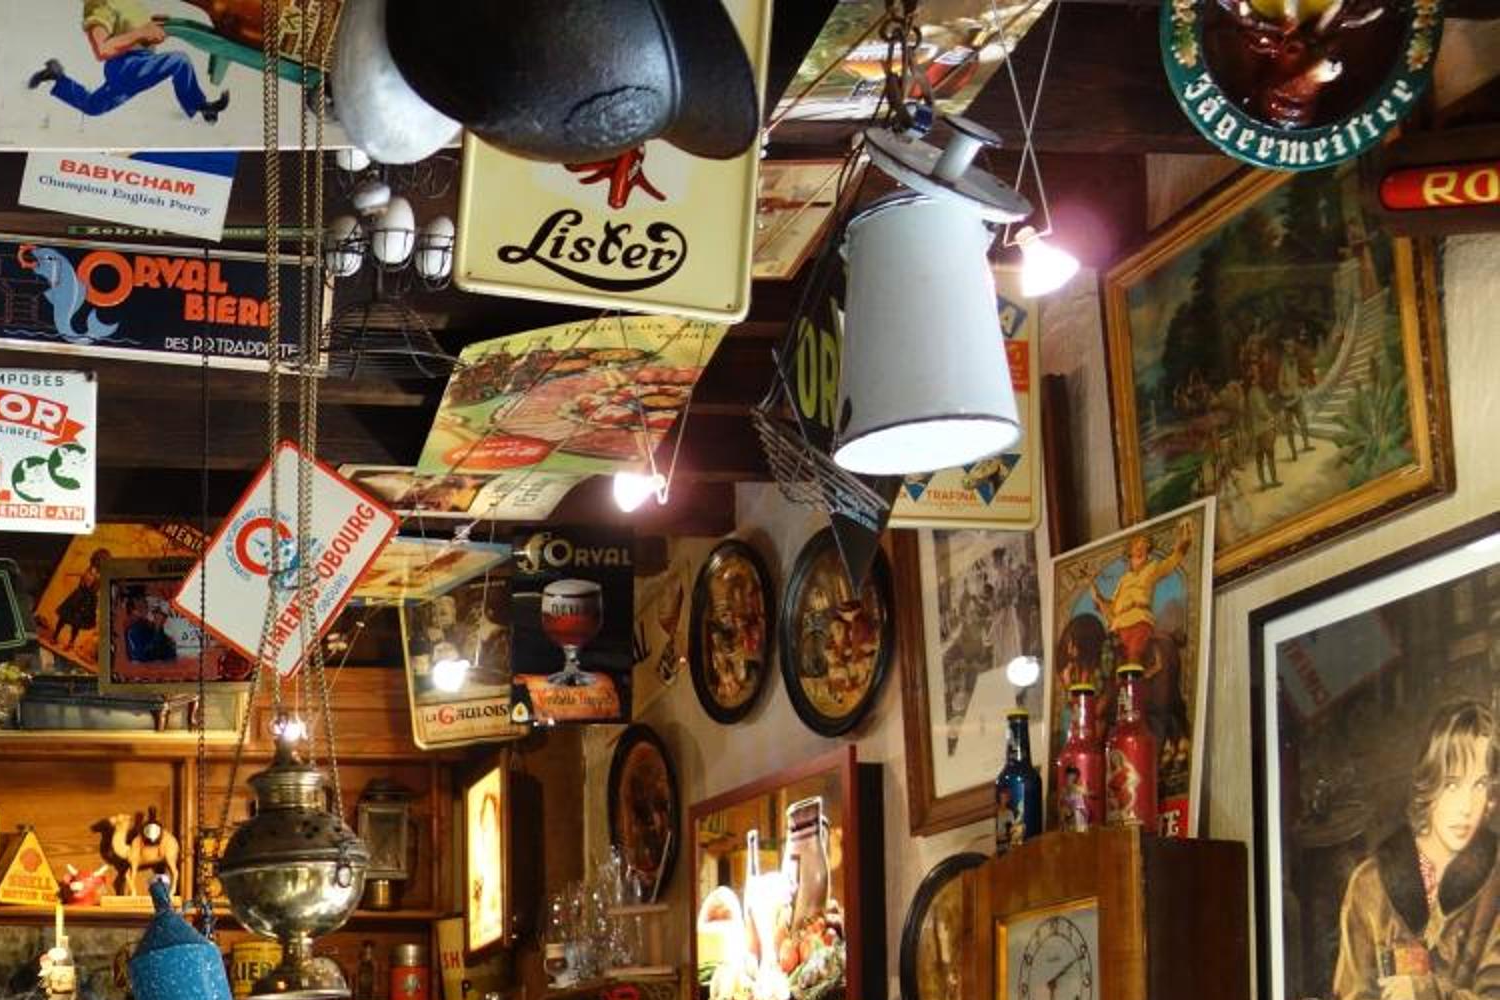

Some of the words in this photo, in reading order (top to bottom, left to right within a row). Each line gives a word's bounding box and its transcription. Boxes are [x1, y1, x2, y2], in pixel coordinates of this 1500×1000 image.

[38, 174, 106, 201] Champion
[109, 186, 165, 211] English
[58, 158, 196, 197] BABYCHAM
[497, 208, 688, 292] Lister
[77, 250, 229, 308] ORVAL
[315, 502, 377, 580] OBOURG
[544, 538, 632, 567] ORVAL
